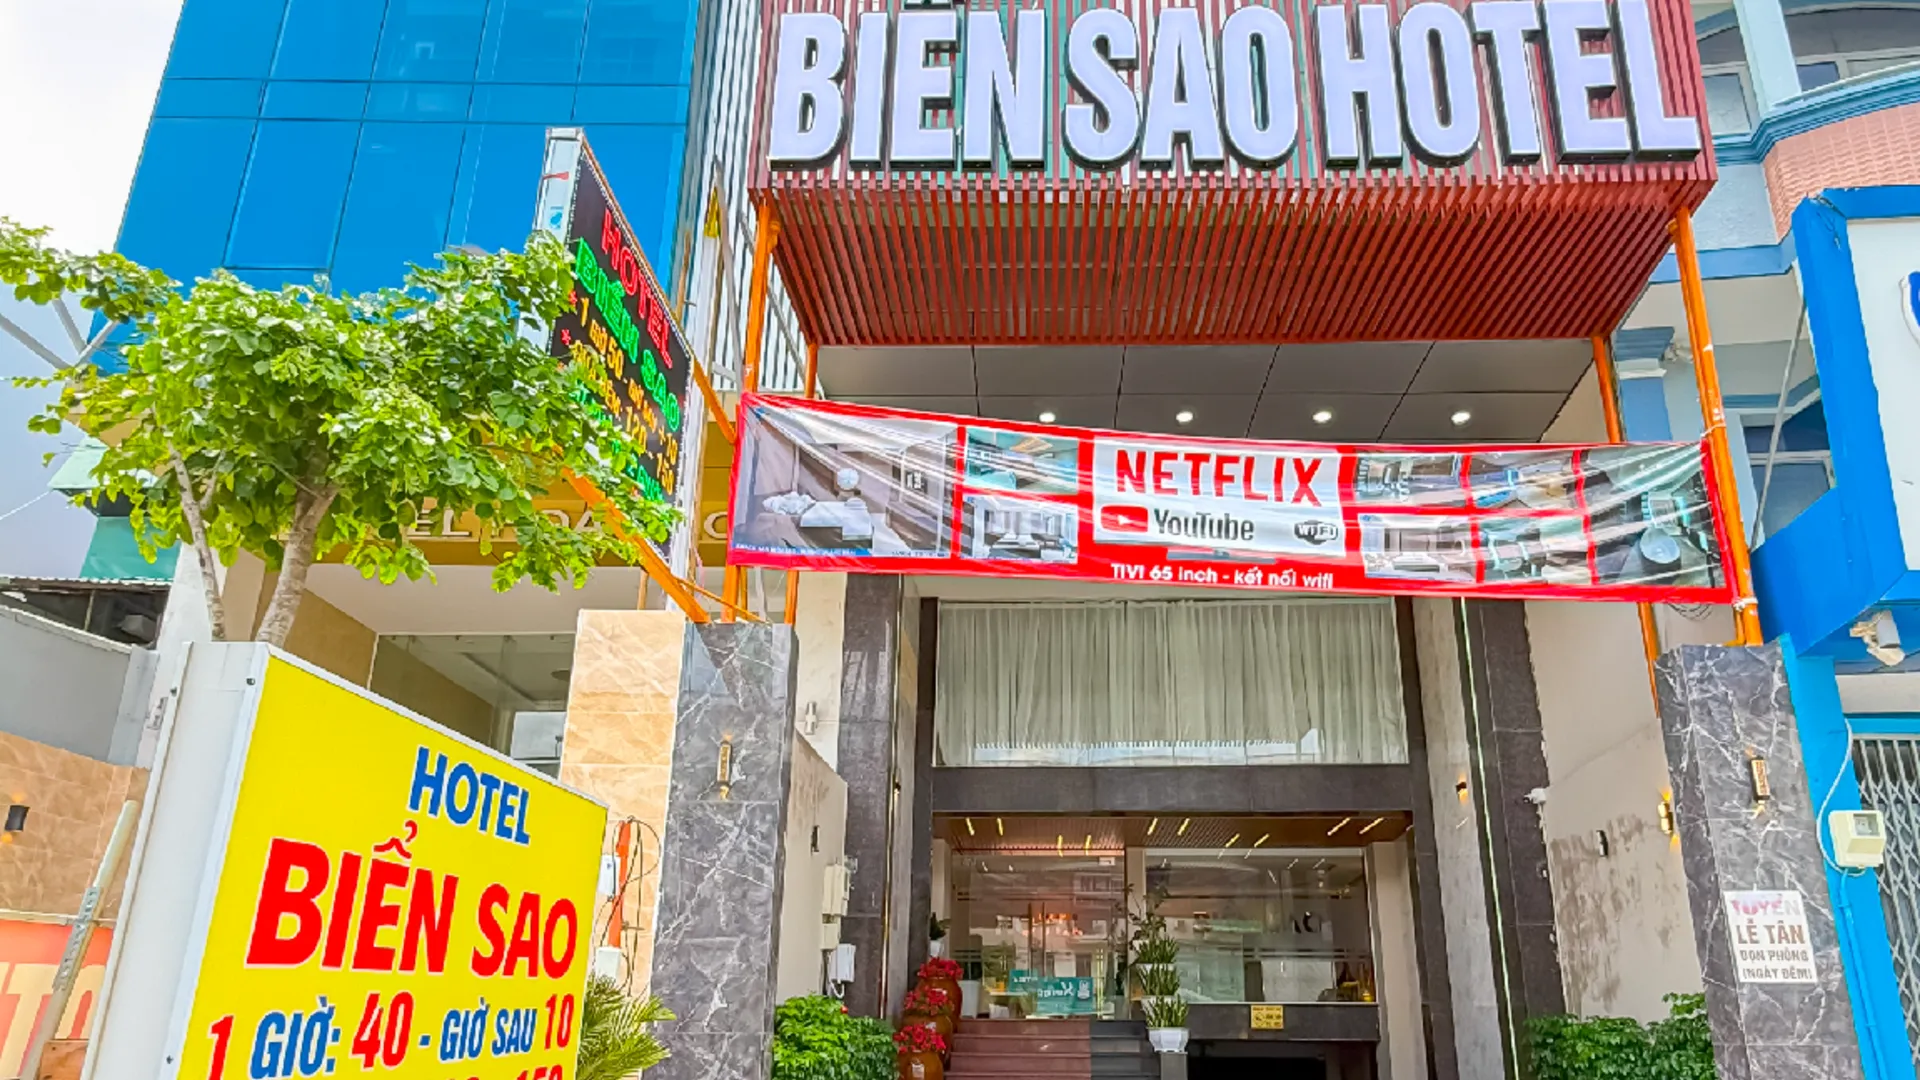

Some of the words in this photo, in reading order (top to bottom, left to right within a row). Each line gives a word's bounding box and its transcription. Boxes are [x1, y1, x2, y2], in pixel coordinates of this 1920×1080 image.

[1064, 5, 1299, 168] SAO
[1316, 0, 1701, 163] HOTEL
[602, 208, 672, 369] HOTEL
[607, 336, 624, 380] 50
[641, 348, 680, 432] SAO
[1116, 450, 1323, 508] NETFLIX
[1154, 508, 1255, 541] YouTube
[1110, 563, 1146, 580] TIVI
[1149, 565, 1174, 581] 65
[408, 745, 531, 845] HOTEL
[245, 819, 460, 973] BIỂN
[470, 882, 579, 979] SAO
[1763, 919, 1806, 945] TÂN
[205, 1014, 235, 1080] 1
[249, 995, 342, 1080] GIỜ:
[350, 990, 416, 1070] 40
[438, 996, 490, 1061] GIỜ
[491, 1007, 538, 1056] SAU
[544, 993, 575, 1050] 10
